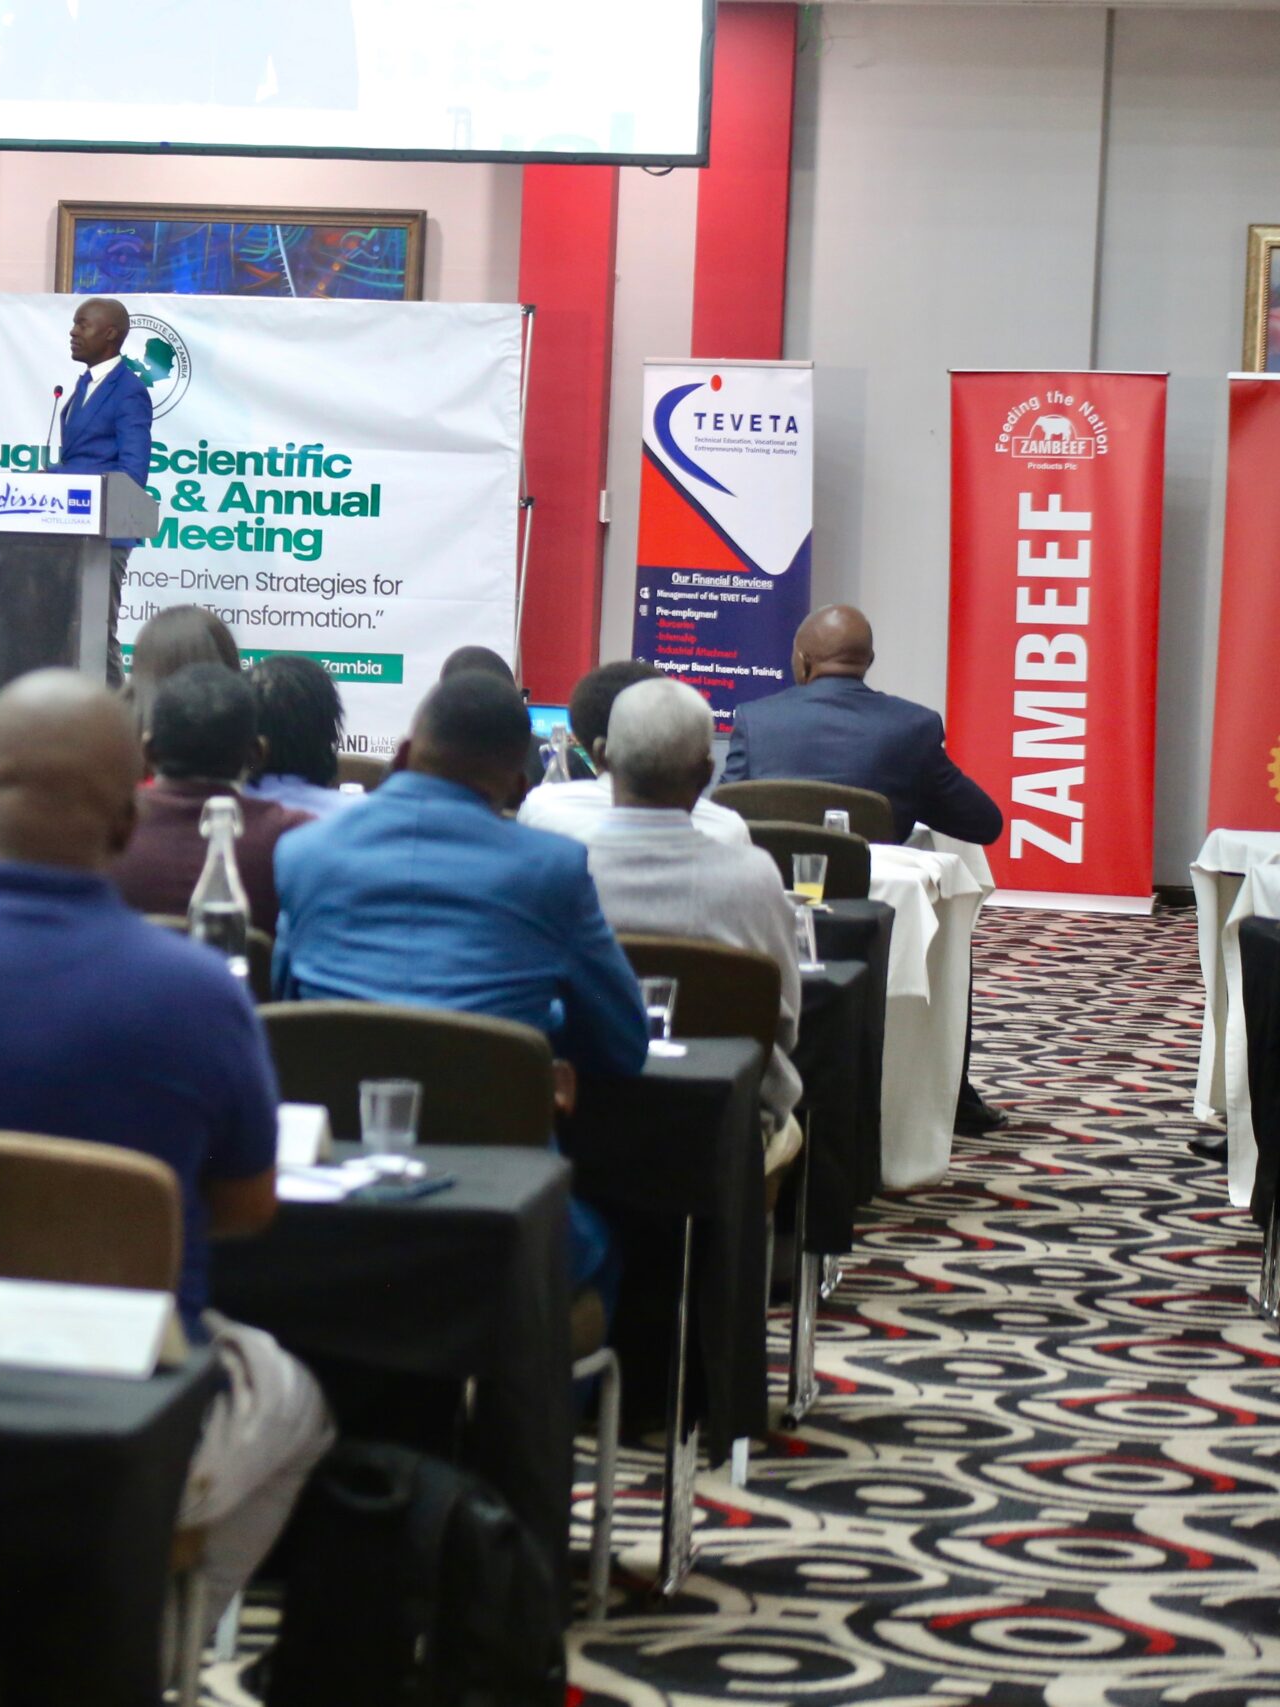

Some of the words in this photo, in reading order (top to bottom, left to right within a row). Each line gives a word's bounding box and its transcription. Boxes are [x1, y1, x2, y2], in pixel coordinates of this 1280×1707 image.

[129, 318, 167, 335] NSTITUTE
[168, 334, 177, 343] OF
[176, 346, 188, 379] ZAMBIA
[694, 412, 799, 434] TEVETA
[995, 396, 1040, 453] Feeding
[1046, 390, 1074, 406] the
[1078, 401, 1108, 455] Nation
[694, 445, 742, 453] Entrepreneurship
[745, 447, 771, 455] Training
[772, 448, 797, 456] Authority
[1020, 440, 1086, 455] ZAMBEEF
[148, 439, 352, 479] Scientific
[1027, 462, 1062, 471] Products
[1064, 462, 1078, 471] Plc
[68, 498, 90, 507] BLU
[170, 480, 208, 512] &
[217, 481, 381, 517] Annual
[120, 568, 248, 591] ence-Driven
[255, 571, 366, 600] Strategies
[373, 574, 403, 596] for
[672, 572, 690, 584] Our
[692, 573, 730, 586] Financial
[732, 575, 774, 589] Services
[656, 589, 699, 601] Management
[699, 591, 708, 600] of
[708, 592, 719, 601] the
[720, 592, 740, 602] TEVET
[740, 594, 759, 603] Fund
[656, 606, 717, 620] Pre-employment
[321, 659, 382, 676] Zambia
[653, 660, 690, 673] Employer
[691, 662, 714, 673] Based
[715, 664, 749, 675] Inservice
[751, 666, 783, 680] Training
[1010, 492, 1092, 864] ZAMBEEF
[336, 734, 368, 753] AND
[370, 736, 396, 746] LINE
[370, 745, 396, 754] AFRICA
